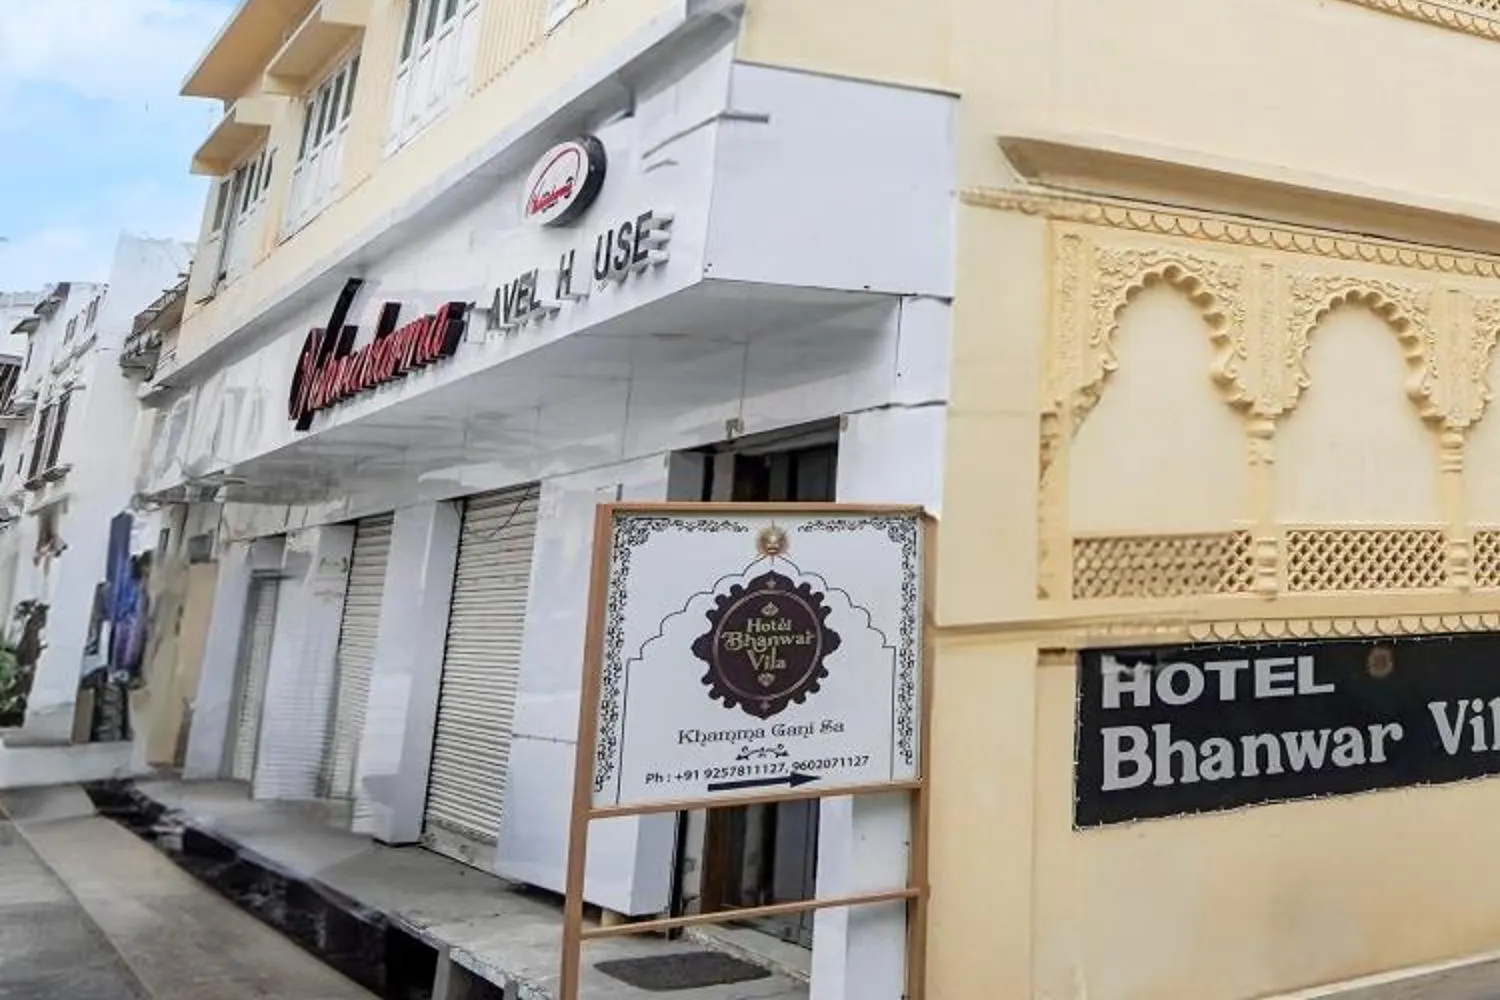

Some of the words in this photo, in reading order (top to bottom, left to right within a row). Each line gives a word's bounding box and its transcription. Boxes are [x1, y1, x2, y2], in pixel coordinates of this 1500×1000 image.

[746, 617, 792, 633] Hotel
[720, 629, 815, 653] Bhanwar
[1102, 655, 1335, 709] HOTEL
[674, 769, 699, 782] +91
[704, 761, 788, 780] 9257811127,
[791, 755, 869, 771] 9602071127
[1101, 721, 1402, 791] Bhanwar
